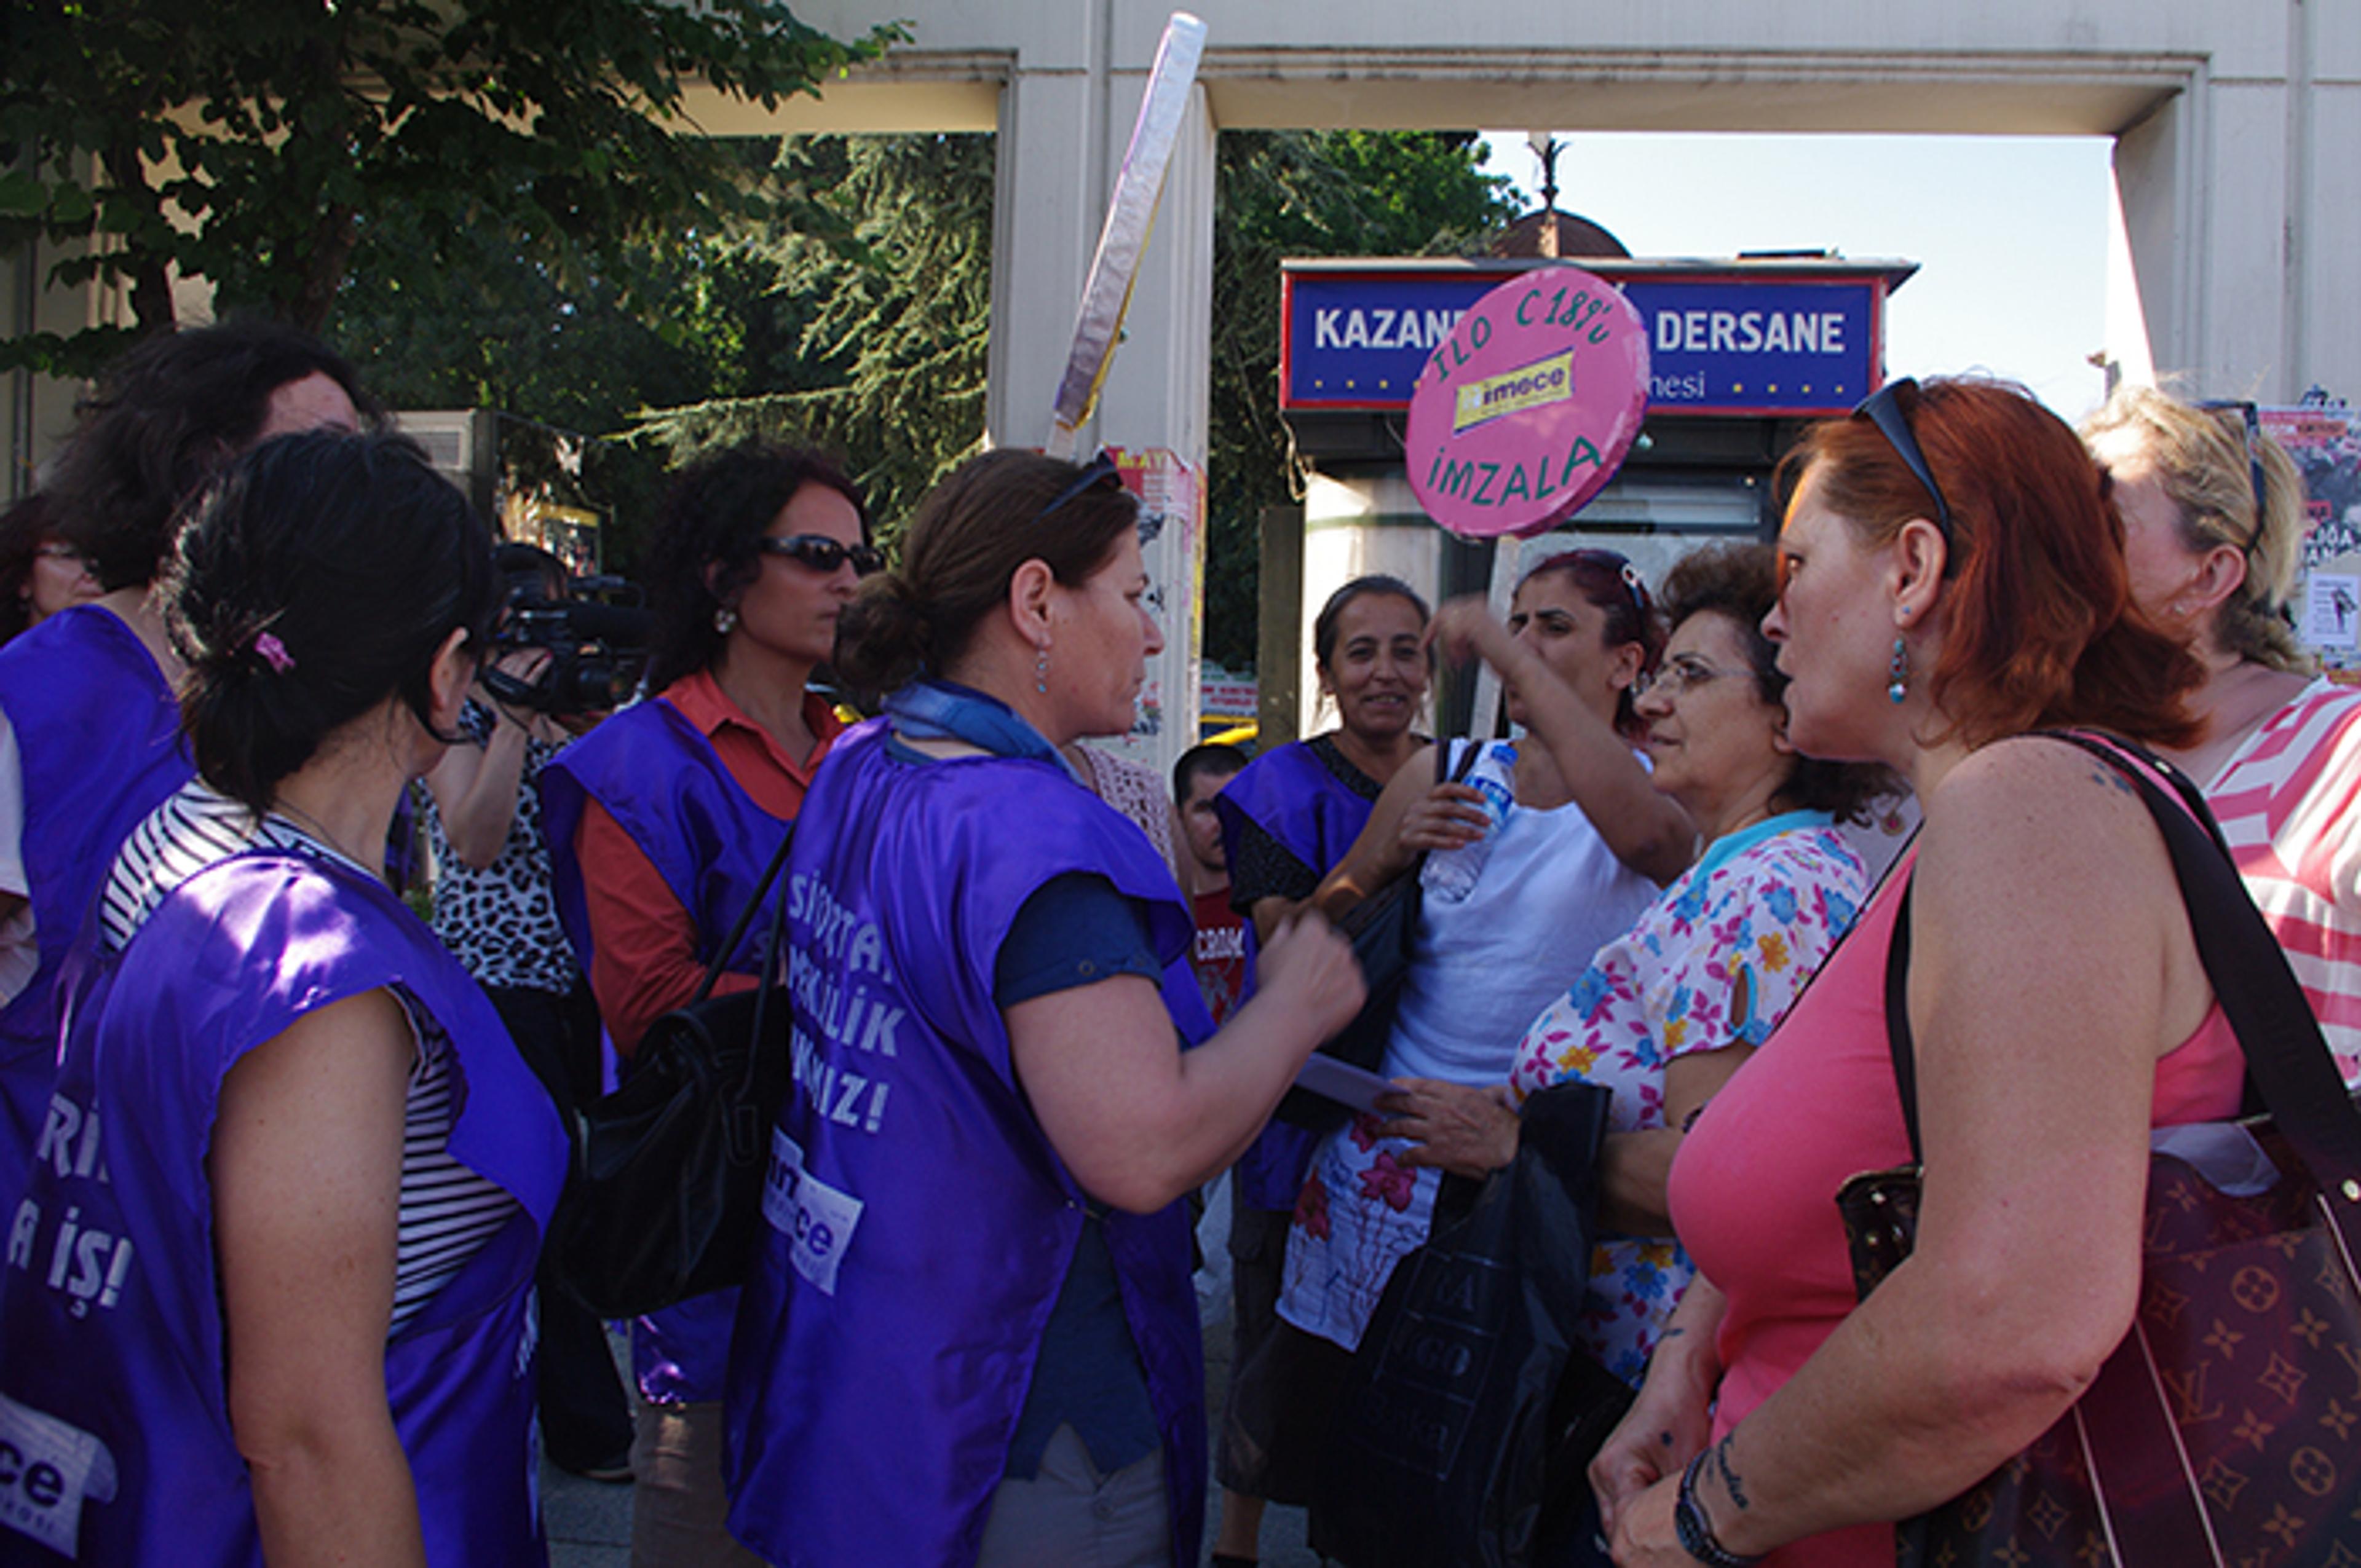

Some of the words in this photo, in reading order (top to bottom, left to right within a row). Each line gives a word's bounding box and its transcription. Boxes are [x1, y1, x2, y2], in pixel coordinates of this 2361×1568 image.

[1315, 309, 1468, 349] KAZAN
[1656, 312, 1845, 353] DERSANE
[1431, 317, 1492, 384] ILO
[1426, 435, 1602, 508] İMZALA
[37, 1091, 110, 1184] Rİ
[47, 1205, 134, 1319] İŞ!
